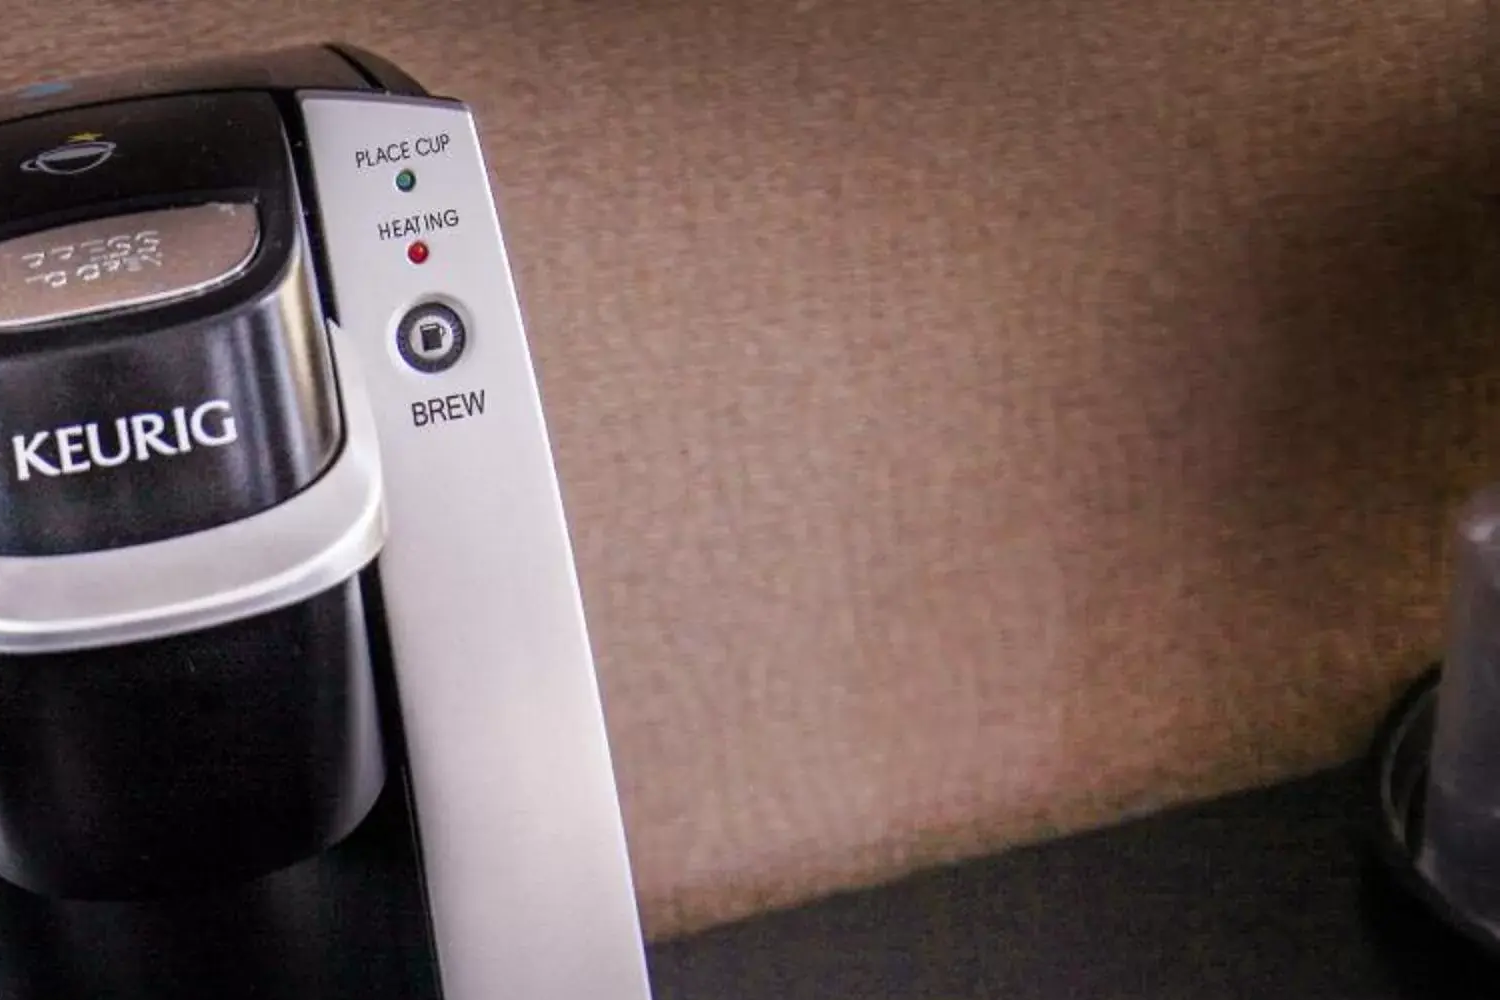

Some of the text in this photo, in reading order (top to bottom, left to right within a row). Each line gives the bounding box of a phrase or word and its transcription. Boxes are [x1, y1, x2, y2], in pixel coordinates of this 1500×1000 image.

[355, 133, 452, 169] PLACE CUP
[377, 208, 461, 241] HEATING
[411, 389, 487, 428] BREW
[11, 399, 238, 481] KEURIG
